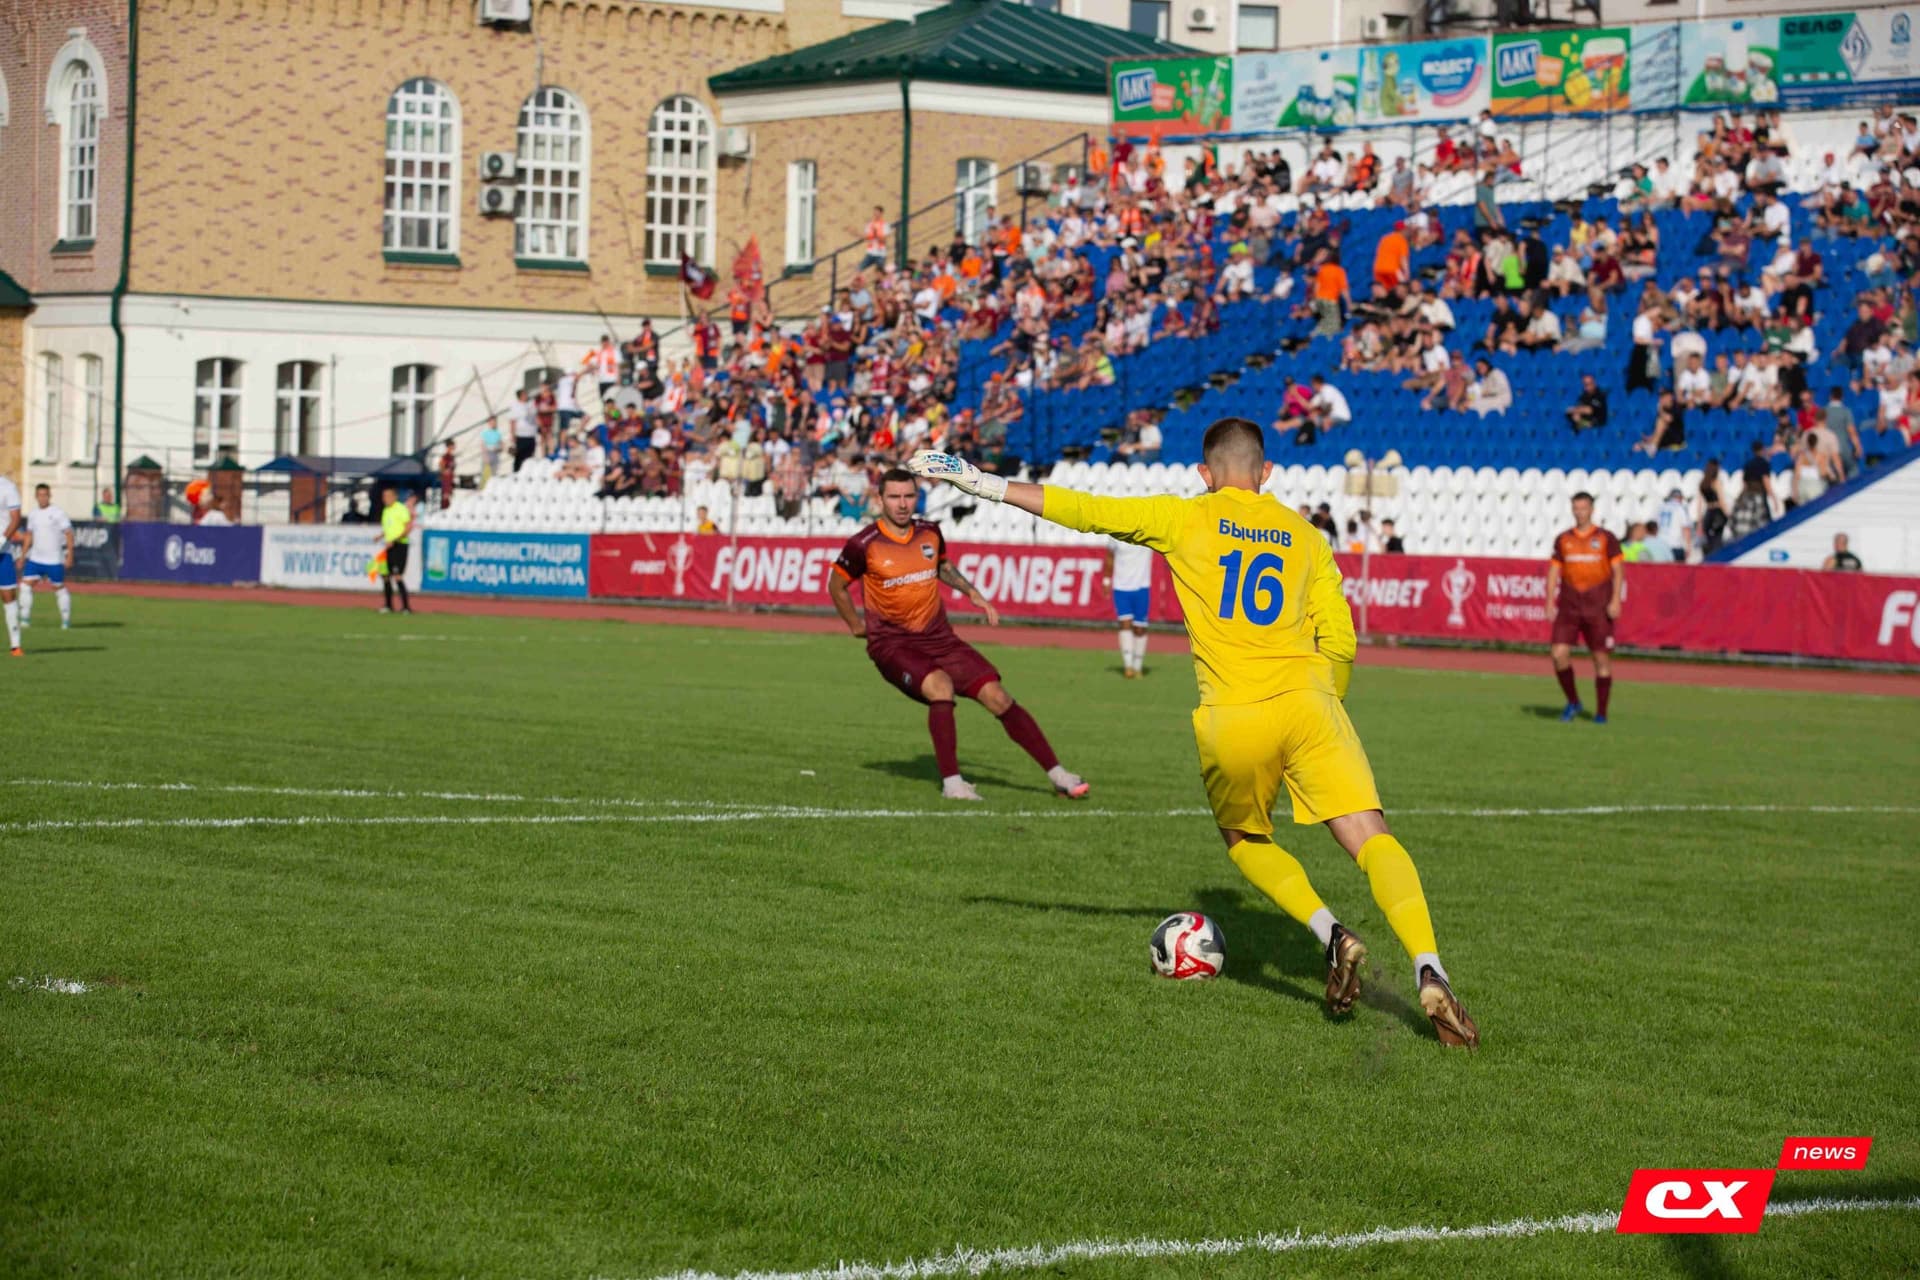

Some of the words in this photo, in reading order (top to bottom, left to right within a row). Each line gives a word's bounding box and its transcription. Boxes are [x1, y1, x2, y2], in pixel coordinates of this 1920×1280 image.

[454, 540, 582, 565] АДМИНИСТРАЦИЯ
[450, 562, 507, 586] ГОРОДА
[510, 565, 586, 586] БАРНАУЛА
[951, 553, 1104, 606] FONBET
[1218, 549, 1284, 626] 16
[1342, 577, 1429, 608] FONBET
